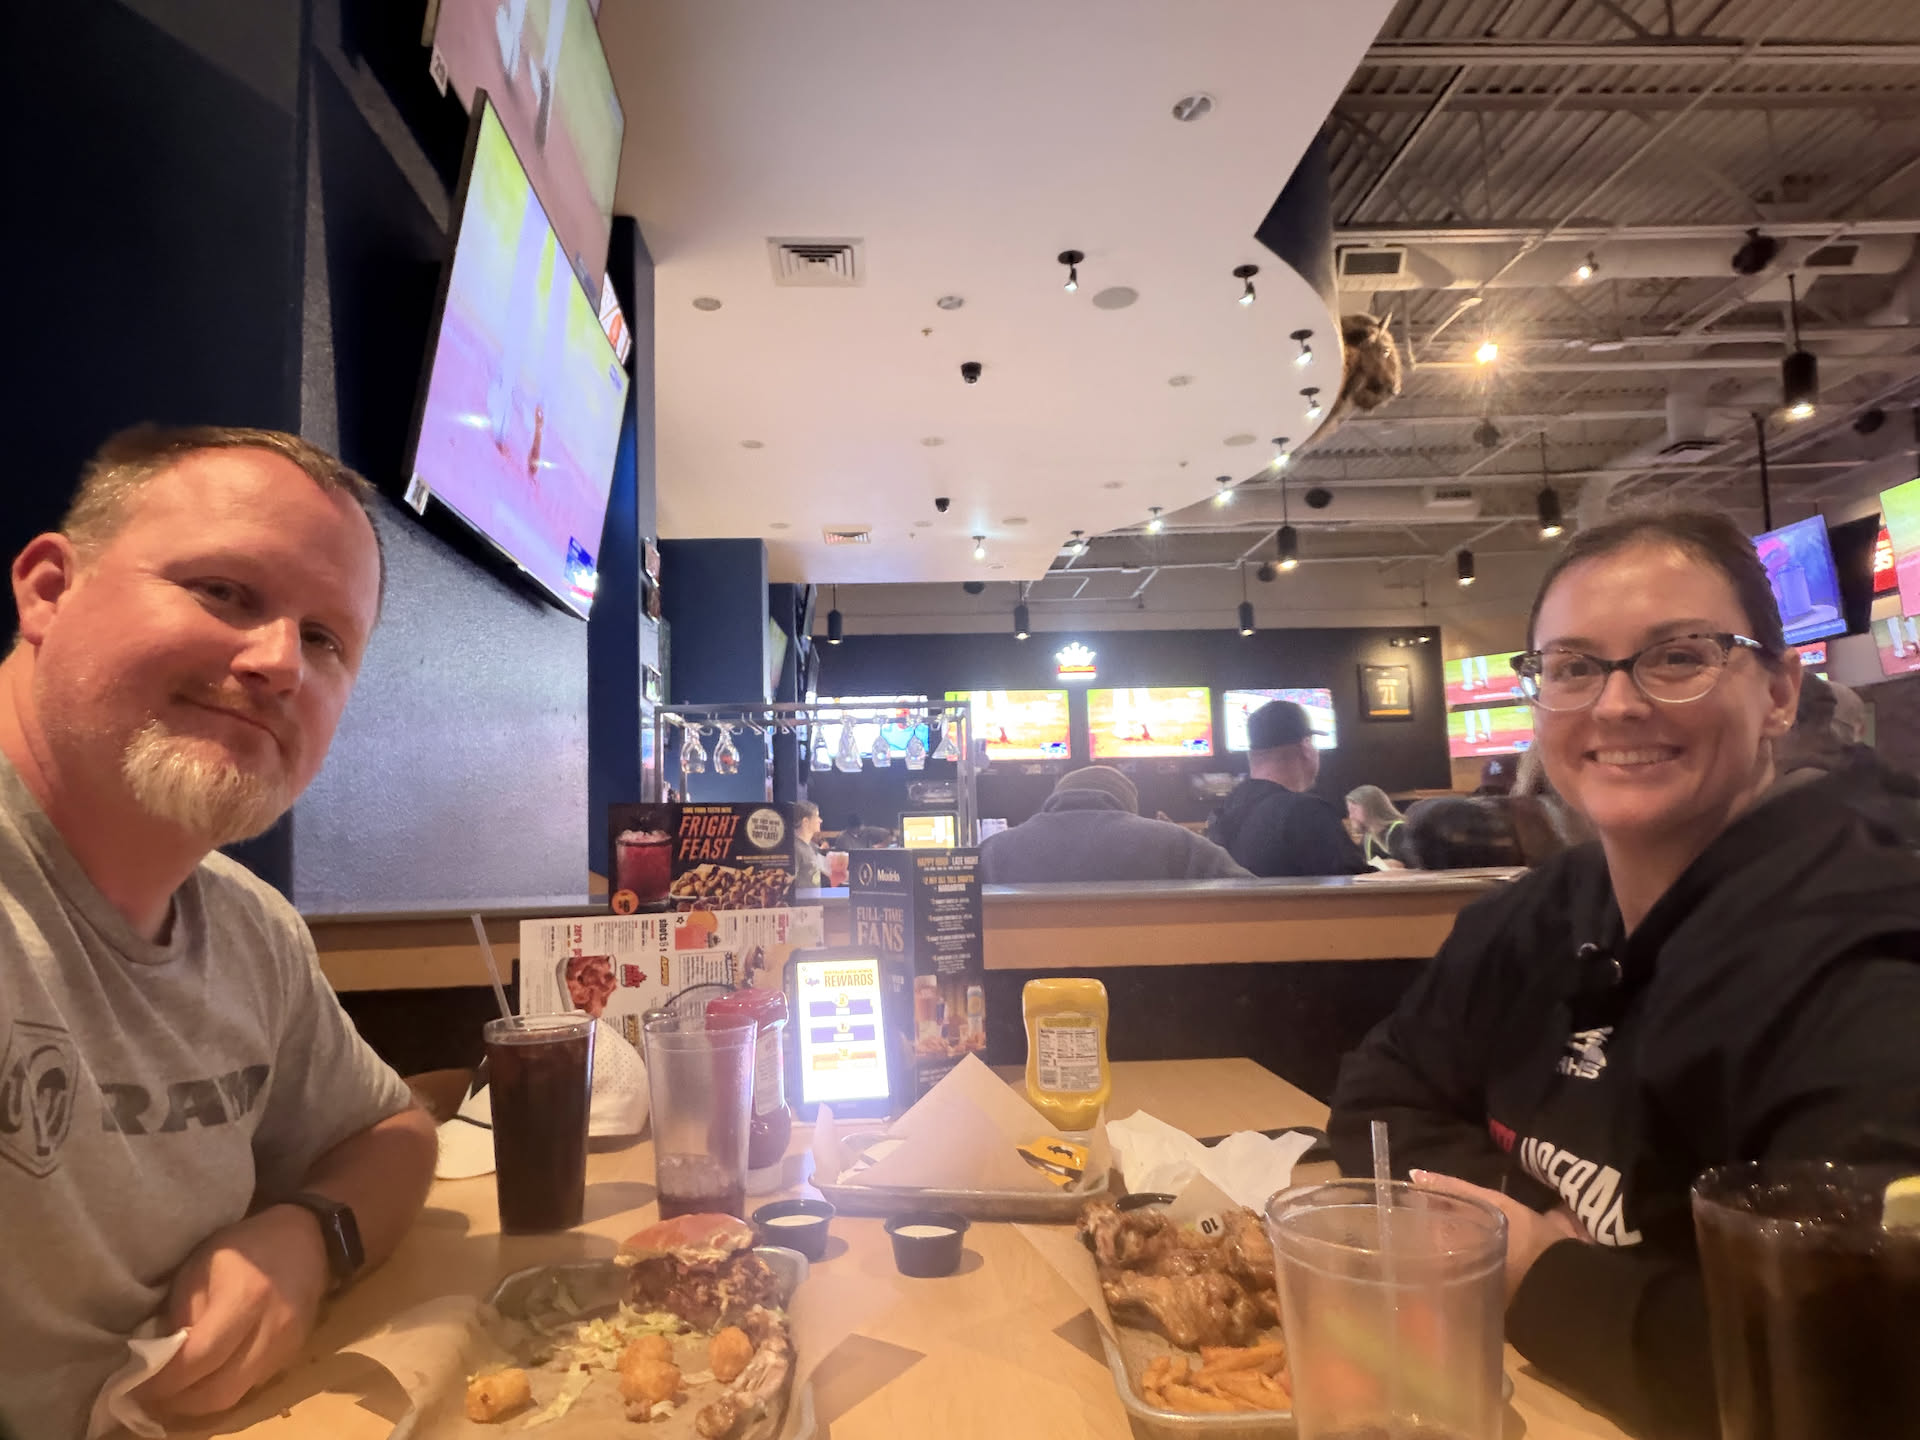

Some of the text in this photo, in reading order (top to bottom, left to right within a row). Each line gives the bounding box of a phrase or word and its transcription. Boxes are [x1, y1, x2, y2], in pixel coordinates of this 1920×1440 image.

[679, 815, 740, 838] FRIGHT
[679, 837, 733, 861] FEAST
[877, 868, 901, 882] Modelo
[857, 906, 904, 922] FULL-TIME
[857, 921, 905, 953] FANS
[824, 974, 874, 988] REWARDS
[1200, 1217, 1219, 1235] 10
